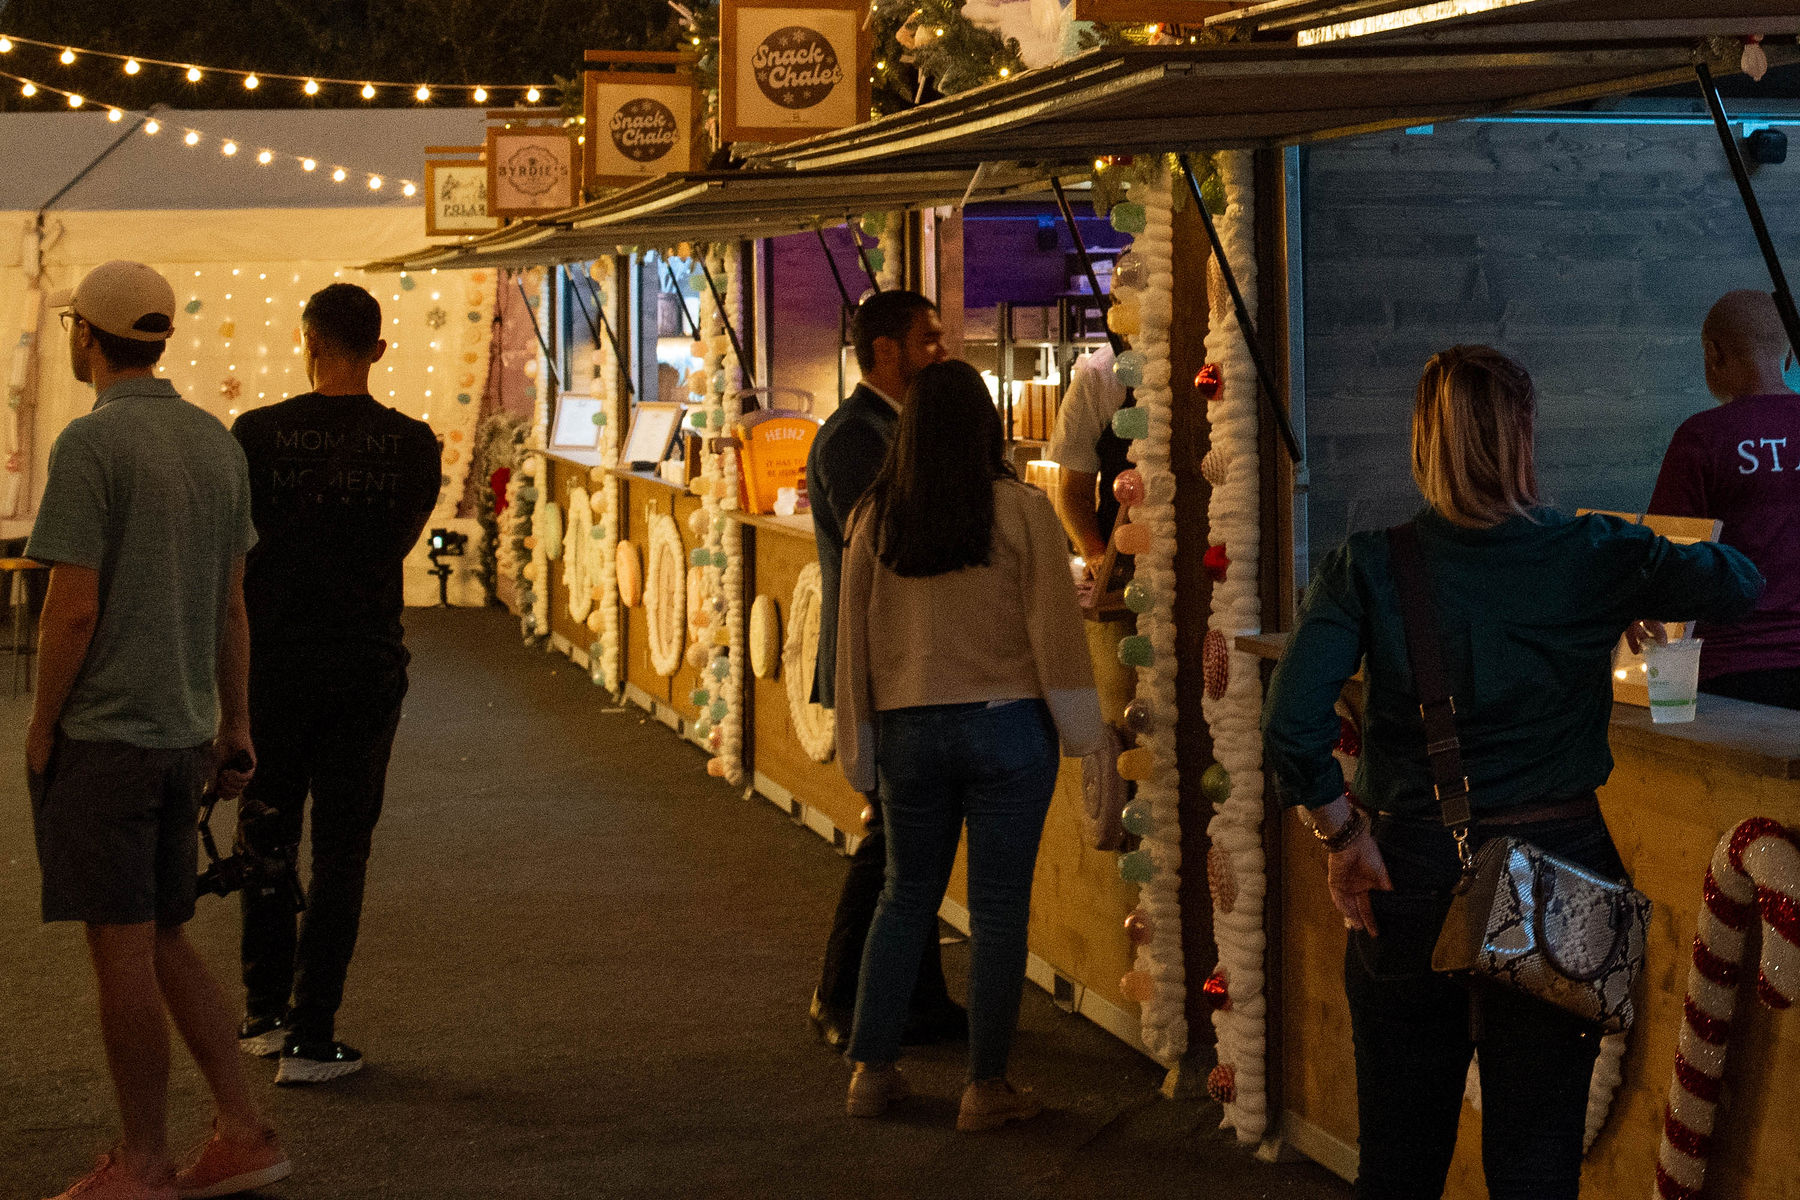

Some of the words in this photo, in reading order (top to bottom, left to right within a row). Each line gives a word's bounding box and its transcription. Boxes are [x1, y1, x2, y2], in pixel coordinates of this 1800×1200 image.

[751, 42, 825, 70] Snack
[768, 63, 844, 89] Chalet
[610, 110, 667, 131] Snack
[622, 128, 680, 146] Chalet
[499, 165, 568, 177] BYRDIE'S
[443, 203, 485, 217] POLAR
[275, 429, 401, 454] MOMNT
[764, 427, 806, 442] HEINZ
